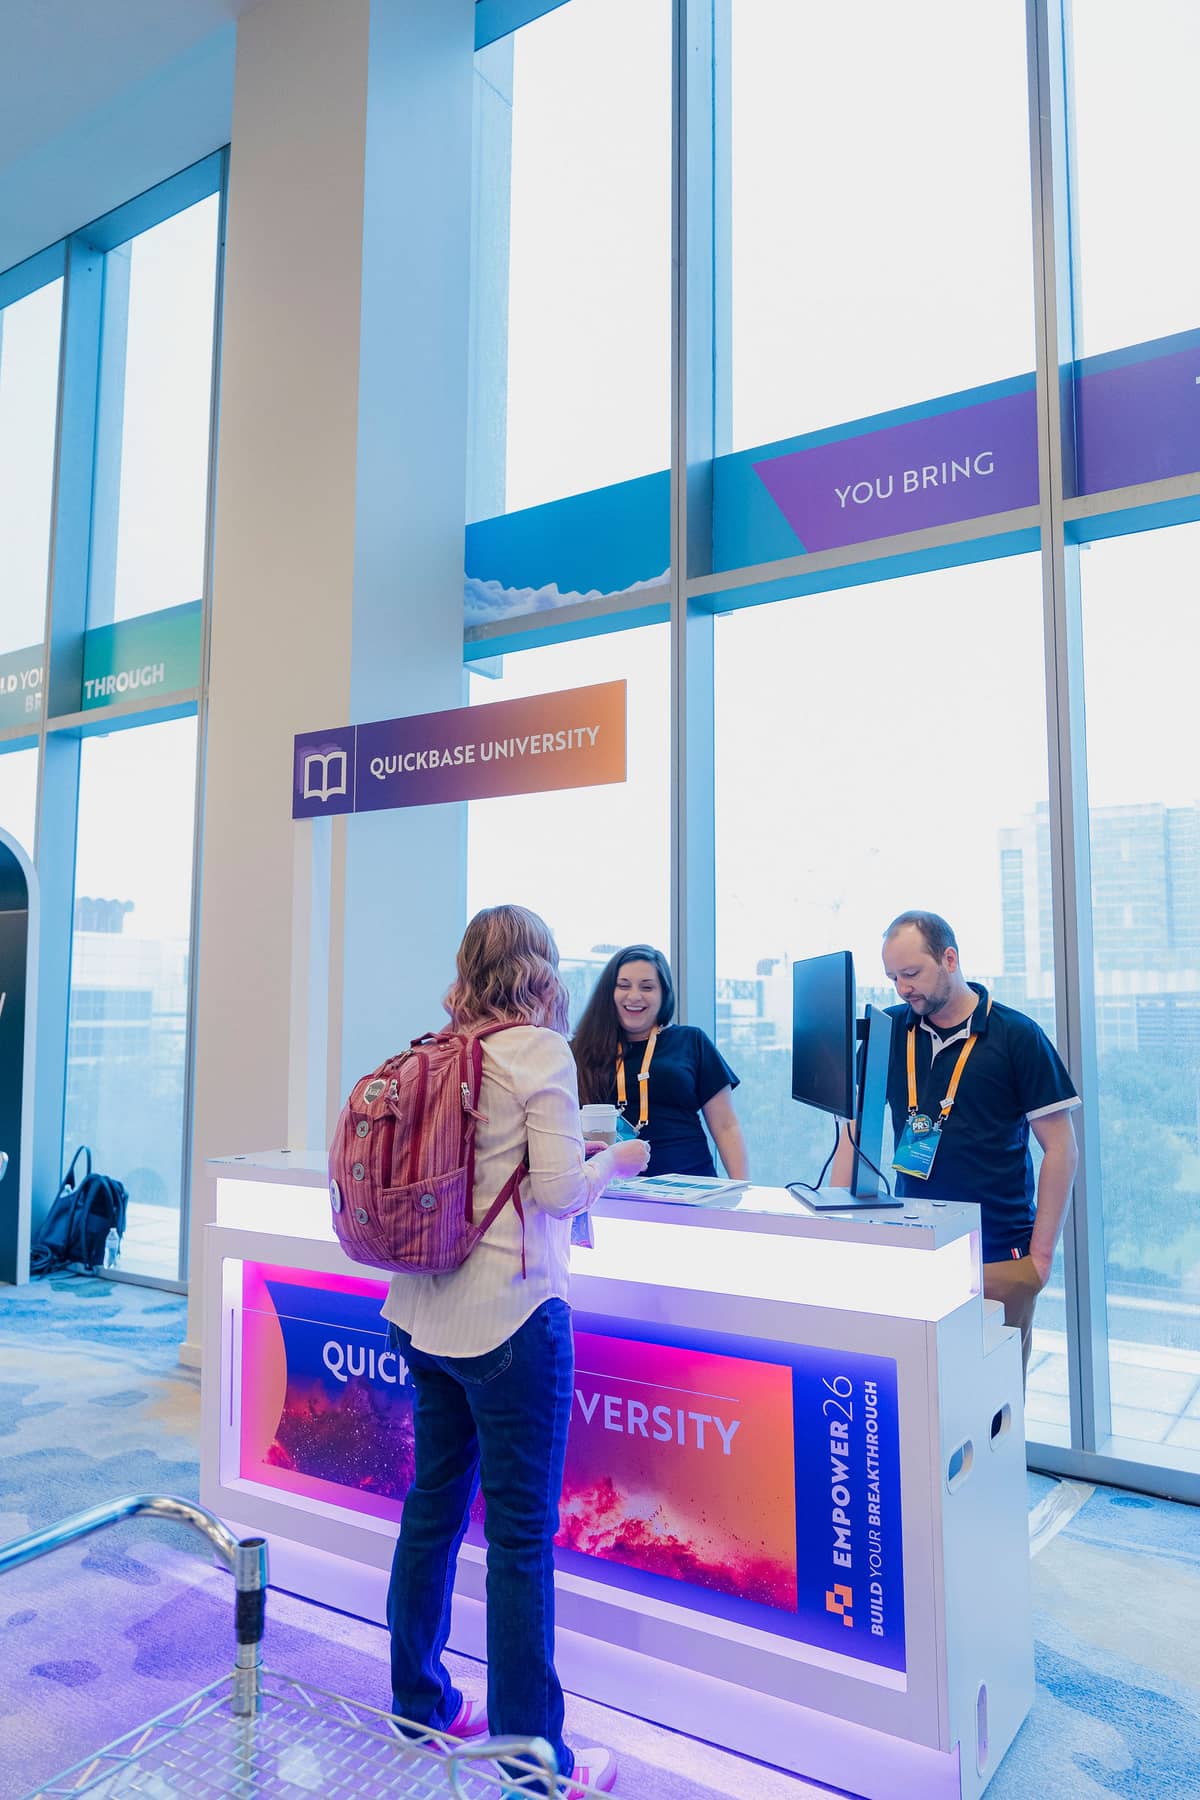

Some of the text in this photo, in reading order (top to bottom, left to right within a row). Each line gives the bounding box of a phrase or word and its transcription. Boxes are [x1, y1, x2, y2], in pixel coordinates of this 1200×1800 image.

[834, 452, 995, 509] YOU BRING
[369, 725, 601, 780] QUICKBASE UNIVERSITY
[570, 1388, 741, 1456] VERSITY
[864, 1380, 884, 1638] BUILD YOUR BREAKTHROUGH
